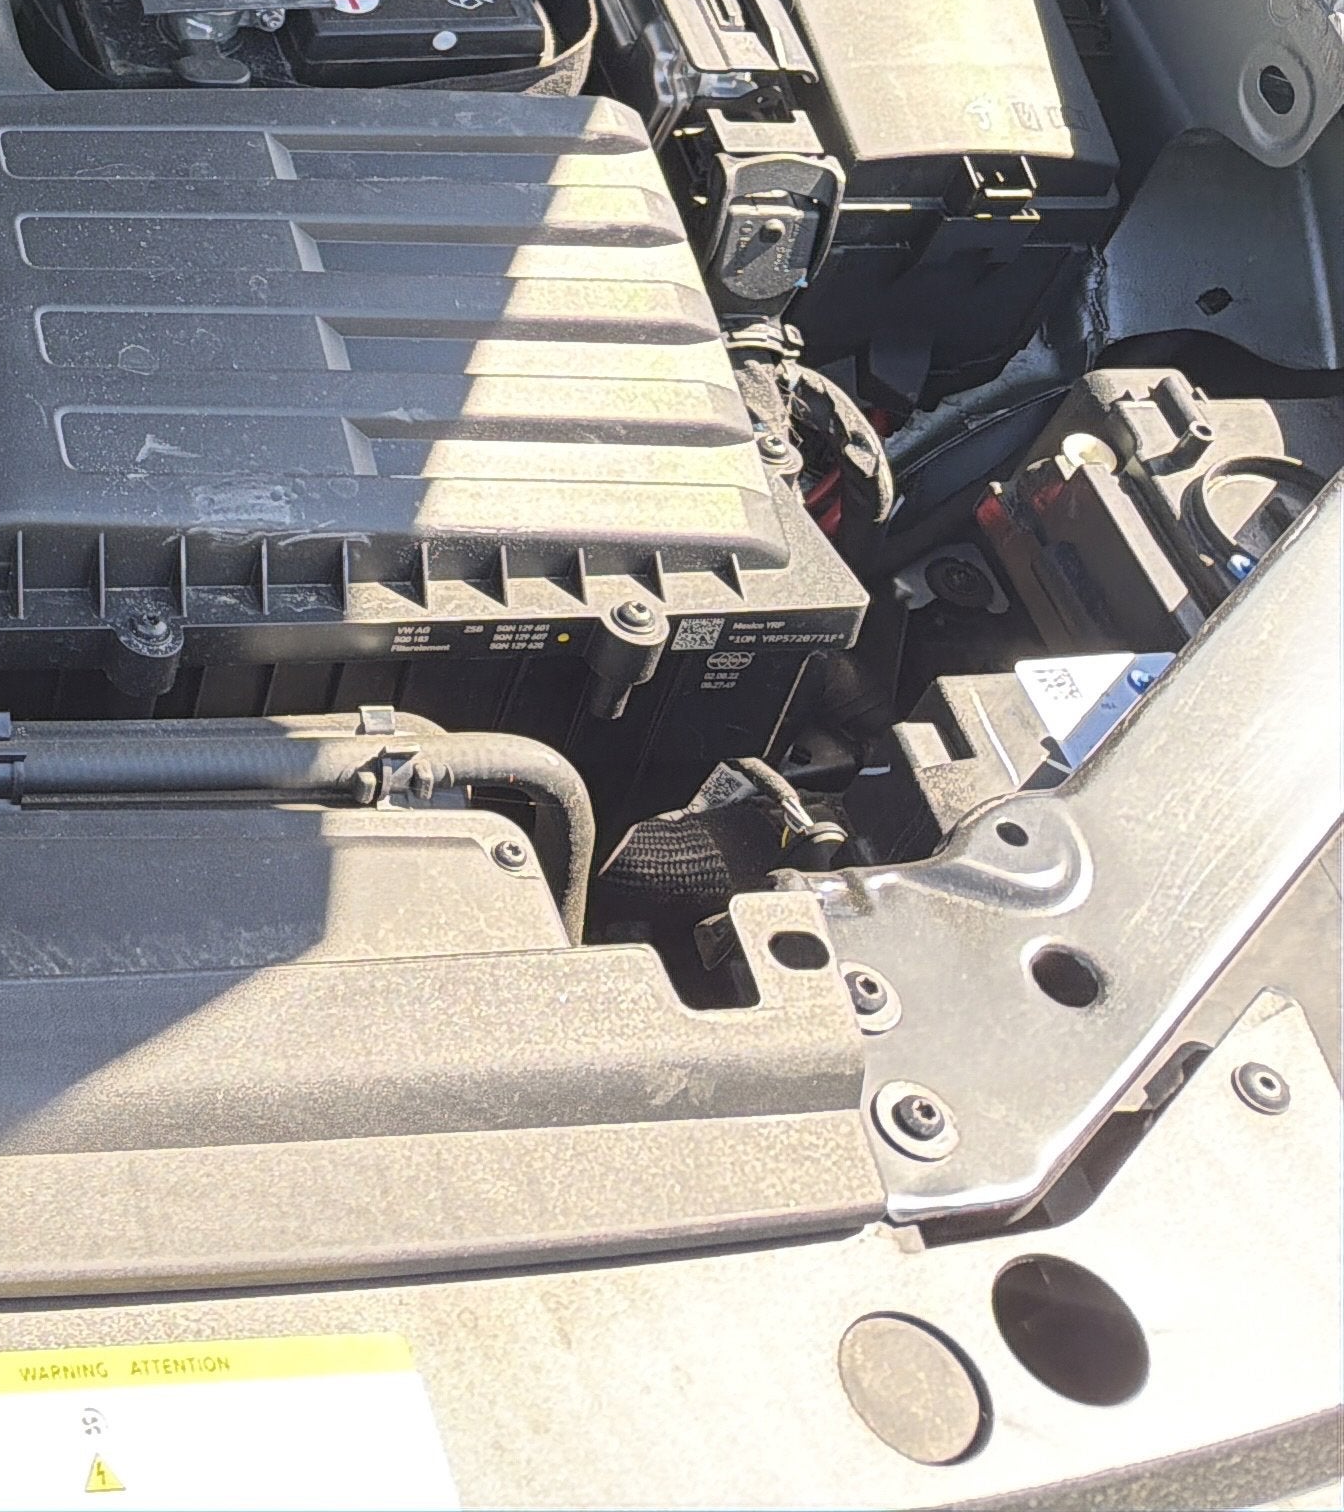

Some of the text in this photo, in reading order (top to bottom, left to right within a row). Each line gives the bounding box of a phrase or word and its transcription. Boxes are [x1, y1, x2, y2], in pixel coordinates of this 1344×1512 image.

[732, 621, 785, 630] Mexico YRP
[397, 626, 431, 635] VW AG
[390, 644, 451, 653] Filterelement
[19, 1356, 231, 1382] WARNING ATTENTION
